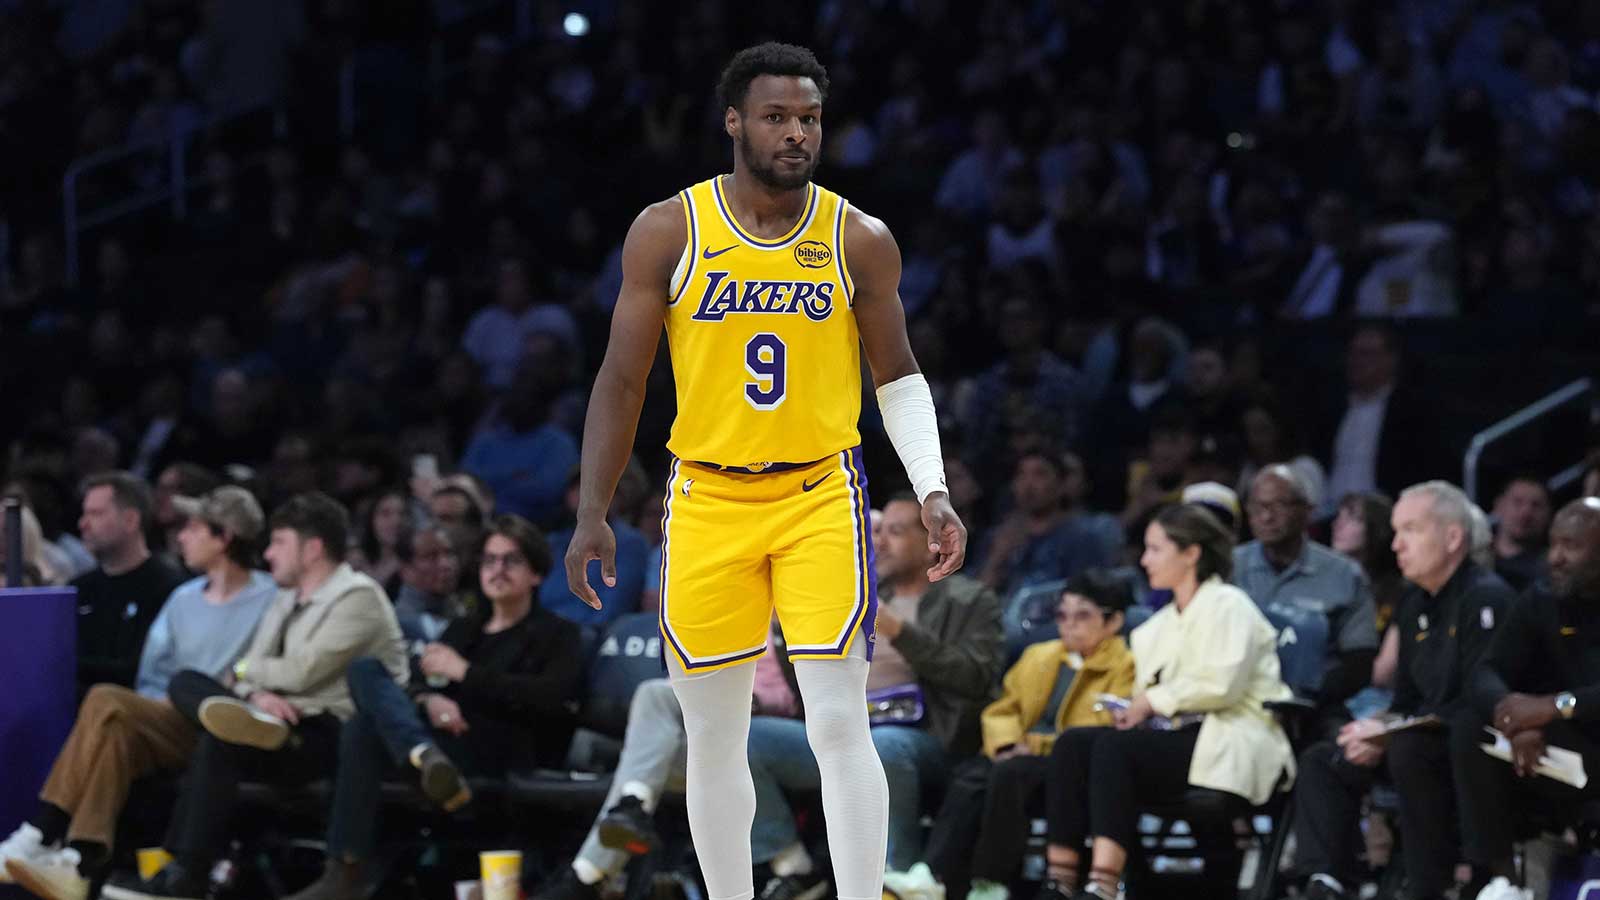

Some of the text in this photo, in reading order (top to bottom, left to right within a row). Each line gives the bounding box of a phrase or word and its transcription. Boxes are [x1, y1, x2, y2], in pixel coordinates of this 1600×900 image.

[798, 247, 830, 261] bibigo
[691, 270, 835, 323] LAKERS
[744, 332, 787, 411] 9
